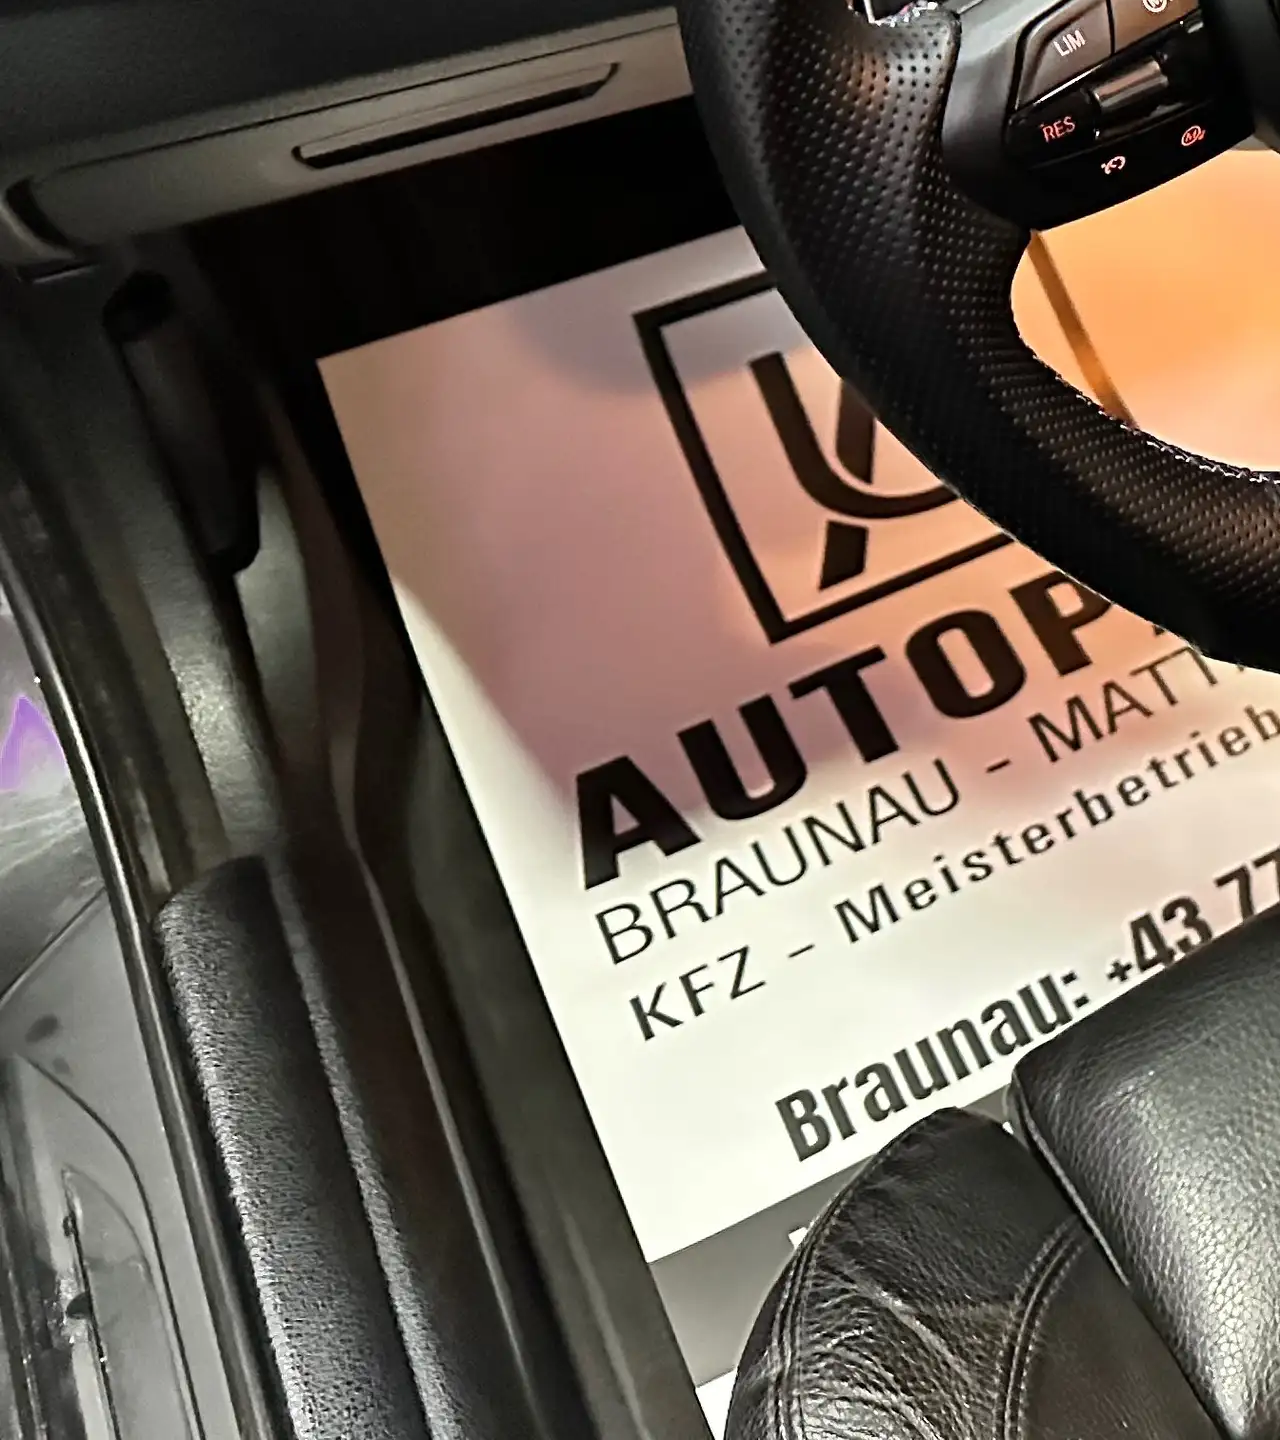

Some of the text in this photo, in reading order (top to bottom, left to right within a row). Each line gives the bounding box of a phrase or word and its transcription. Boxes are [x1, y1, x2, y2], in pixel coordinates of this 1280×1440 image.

[1053, 29, 1086, 58] LIM
[1041, 115, 1076, 143] RES
[594, 757, 961, 966] BRAUNAU
[986, 758, 1011, 774] -
[629, 944, 768, 1043] KFZ
[787, 942, 816, 960] -
[774, 969, 1091, 1163] Braunau:
[1107, 896, 1214, 984] +43
